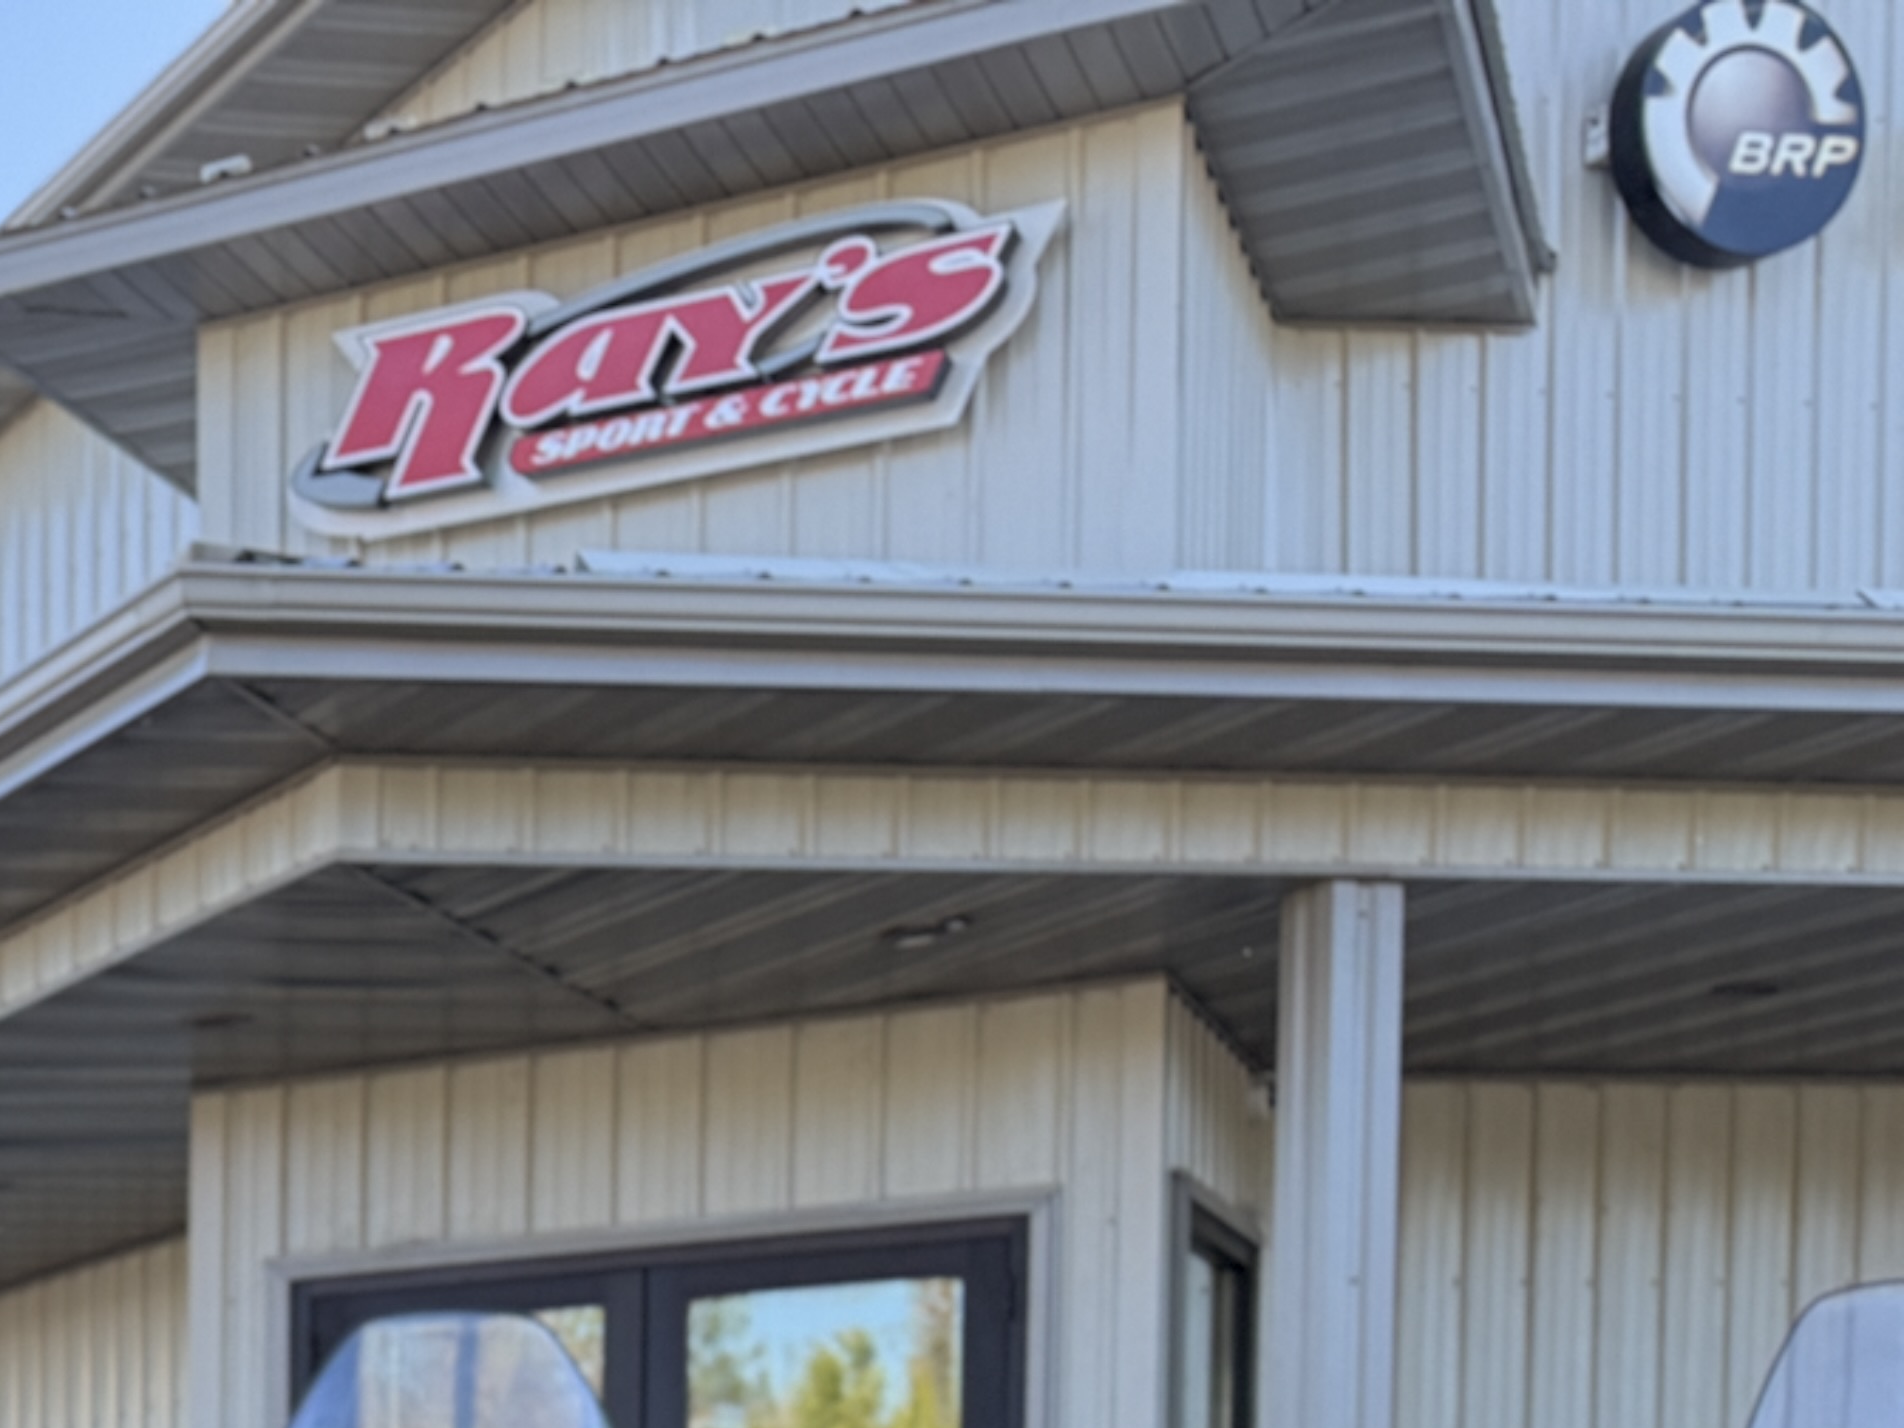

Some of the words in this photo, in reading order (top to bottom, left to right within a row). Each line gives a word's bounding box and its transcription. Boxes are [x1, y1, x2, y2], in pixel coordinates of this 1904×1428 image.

[1728, 130, 1860, 179] BRP
[529, 403, 701, 466] SPORT
[703, 394, 748, 429] &
[758, 357, 925, 418] CYCLE
